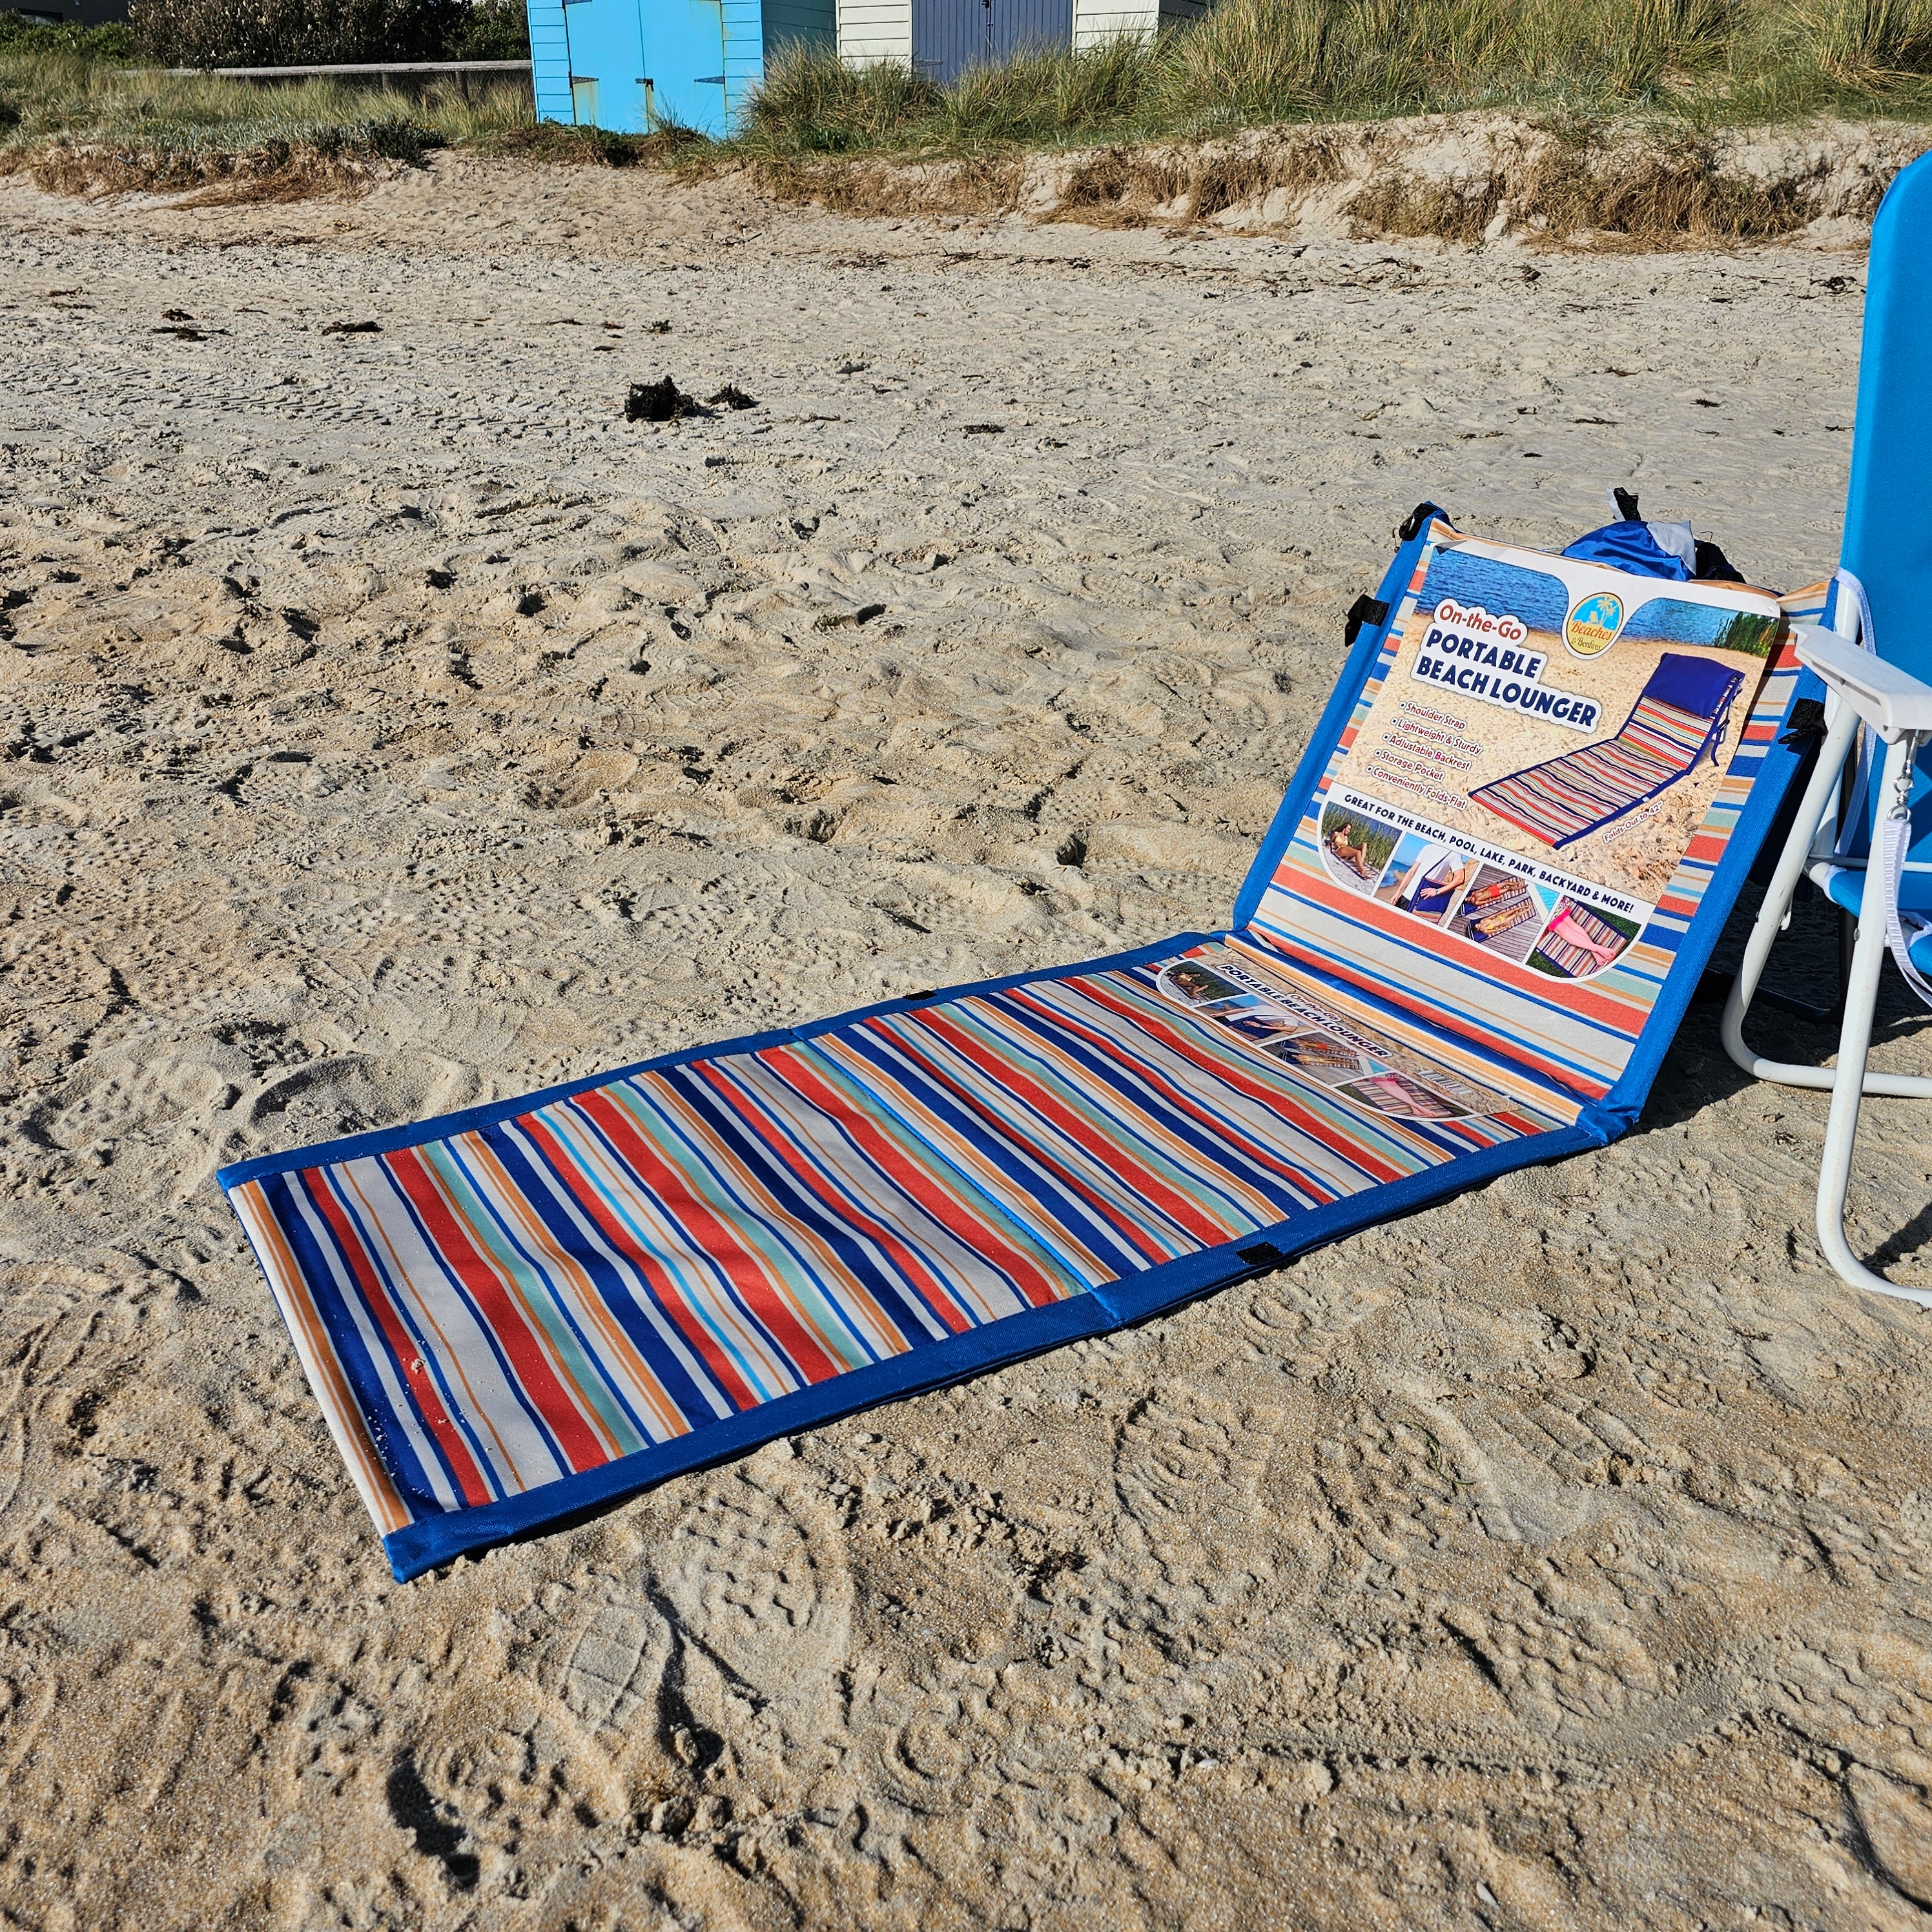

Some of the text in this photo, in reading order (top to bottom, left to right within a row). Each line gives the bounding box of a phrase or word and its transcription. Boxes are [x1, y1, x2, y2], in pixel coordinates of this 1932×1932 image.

[1439, 604, 1522, 640] On-the-Go
[1571, 621, 1612, 641] Beaches
[1426, 629, 1541, 678] PORTABLE
[1577, 637, 1601, 650] Bonfires
[1417, 655, 1596, 726] BEACH LOUNGER
[1406, 703, 1465, 730] Shoulder Strap
[1389, 735, 1470, 770] Adjustable Backrest
[1398, 719, 1481, 754] Lightweight & Sturdy
[1381, 752, 1443, 781] Storage Pocket
[1373, 768, 1466, 808] Conveniently Folds-Flat
[1605, 819, 1638, 841] Folds-Out
[1344, 794, 1634, 913] GREAT FOR THE BEACH, POOL, LAKE, PARK, BACKYARD & MORE!
[1220, 965, 1388, 1057] PORTABLE BEACH LOUNGER
[1291, 994, 1339, 1021] On-the-Go
